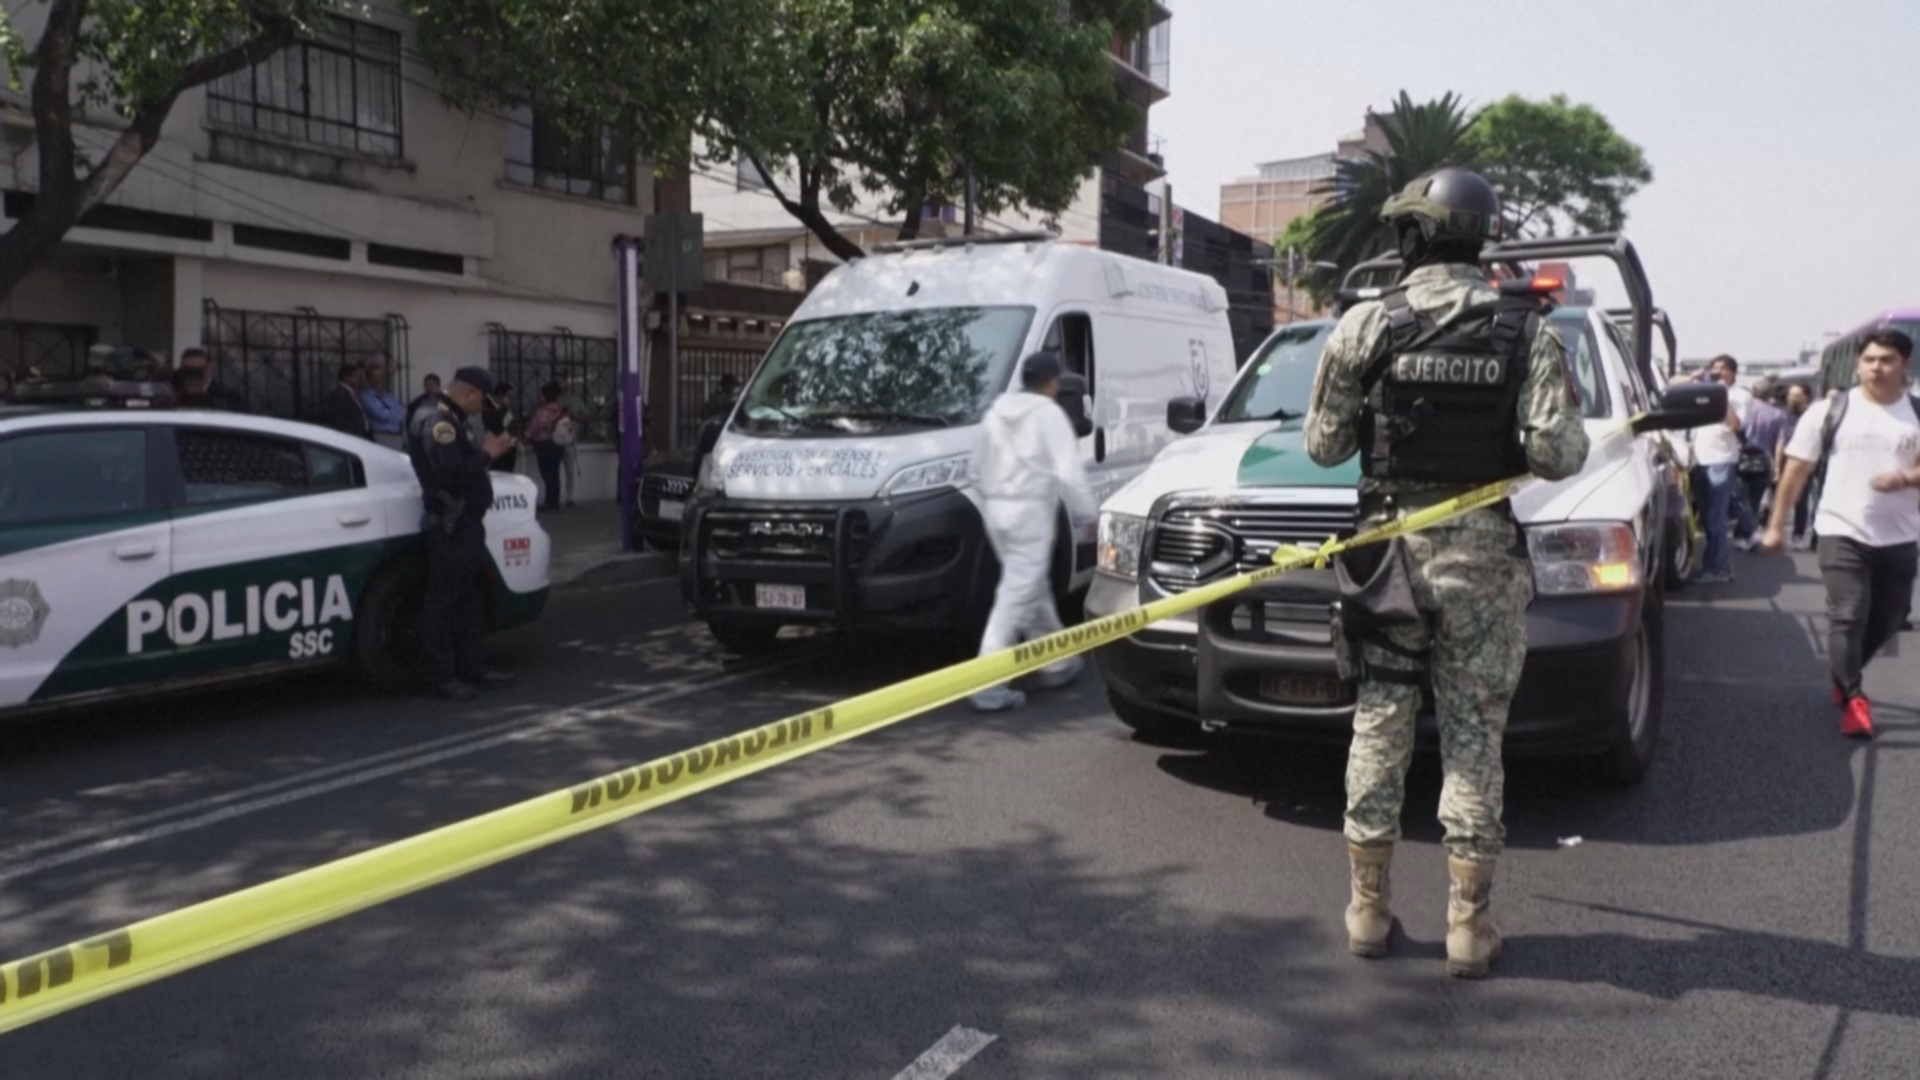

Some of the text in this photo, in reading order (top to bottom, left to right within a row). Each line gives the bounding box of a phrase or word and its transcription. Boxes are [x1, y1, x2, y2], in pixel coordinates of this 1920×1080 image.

[727, 462, 794, 479] SERVICIOS
[490, 493, 529, 519] VITAS
[127, 574, 353, 654] POLICIA
[289, 629, 333, 658] SSC
